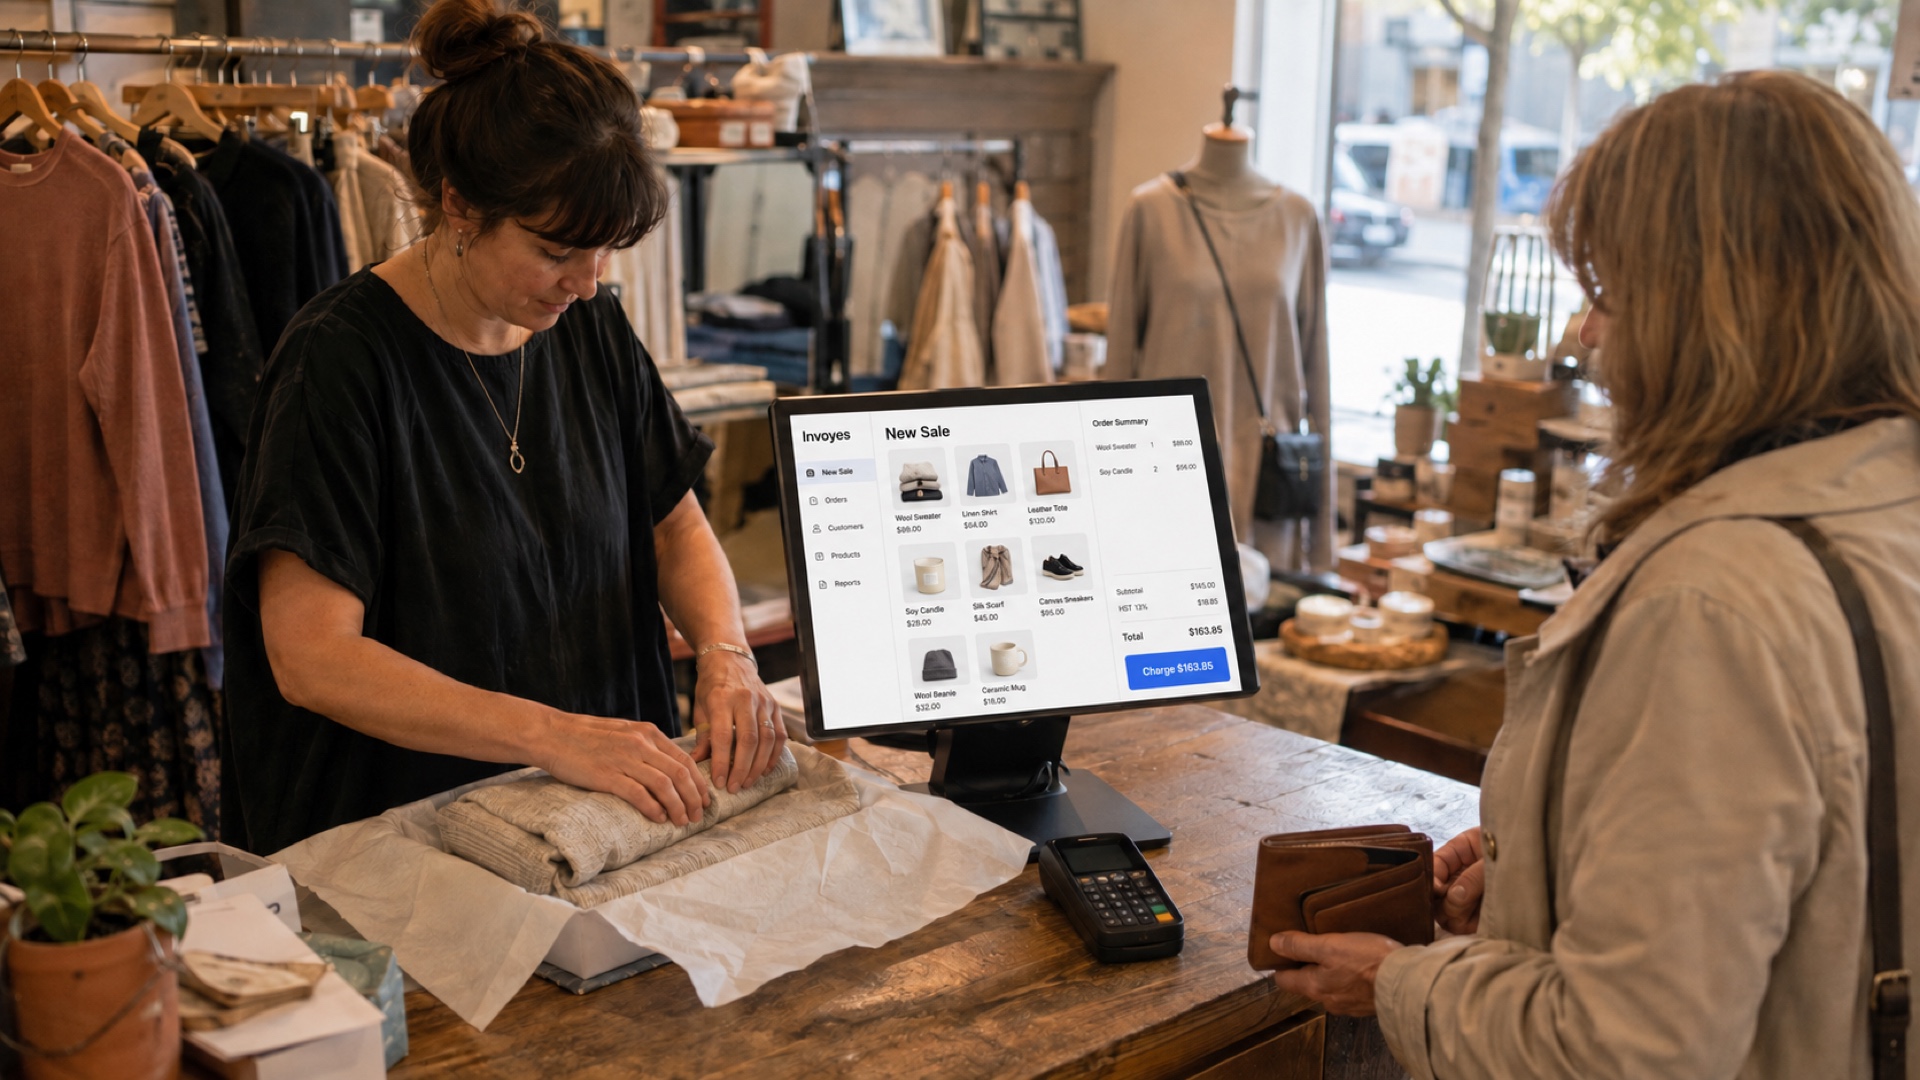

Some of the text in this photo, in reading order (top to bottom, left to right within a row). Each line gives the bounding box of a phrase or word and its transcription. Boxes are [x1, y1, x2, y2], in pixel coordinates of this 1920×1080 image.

[1092, 417, 1148, 427] Order Summary
[802, 430, 851, 444] Invoyes
[885, 425, 951, 440] New Sale
[1113, 442, 1137, 451] Sweater
[821, 466, 853, 476] New Sale
[1099, 467, 1133, 476] Soy Candle
[825, 496, 848, 504] Orders
[961, 508, 998, 518] Linen Shirt
[1027, 504, 1068, 514] Leather Tote
[895, 512, 942, 522] Wool Sweater
[1028, 516, 1056, 526] $120.00
[827, 523, 865, 532] Customers
[830, 550, 861, 560] Products
[834, 579, 861, 588] Reports
[1116, 586, 1144, 595] Subtotal
[985, 600, 1005, 609] Scarf
[1038, 595, 1094, 606] Canvas Sneakers
[905, 605, 945, 616] Soy Candle
[973, 613, 999, 622] $45.00
[1188, 625, 1223, 637] $163.85
[1122, 632, 1144, 641] Total
[1142, 661, 1214, 677] Charge $163.85
[981, 683, 1026, 694] Ceramic Mug
[914, 689, 957, 700] Wool Beanie
